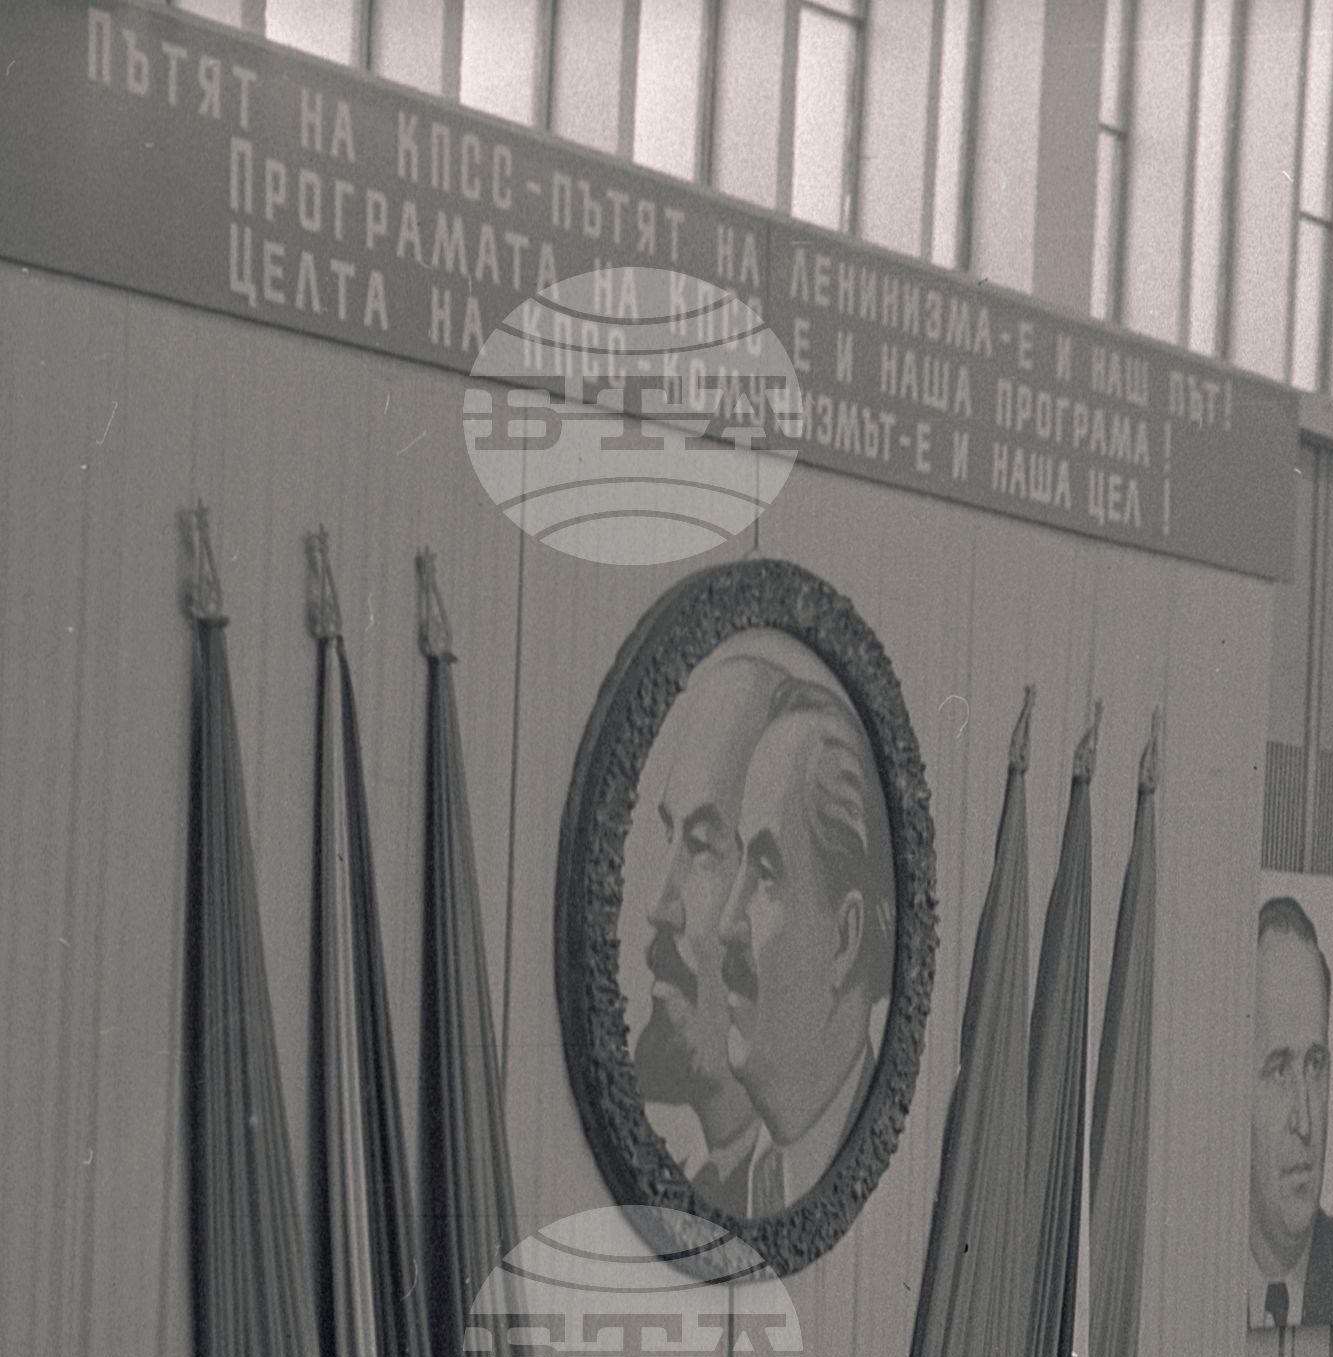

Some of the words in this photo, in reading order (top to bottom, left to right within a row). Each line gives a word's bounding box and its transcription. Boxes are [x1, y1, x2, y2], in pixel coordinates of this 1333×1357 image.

[88, 7, 257, 131] ПЪТЯТ
[302, 87, 355, 163] НА
[717, 223, 760, 288] НА
[1056, 334, 1073, 382] И
[1091, 348, 1150, 407] НАШ
[230, 136, 561, 301] ПРОГРАМАТА
[594, 257, 639, 322] НА
[668, 267, 764, 355] КПСС
[793, 317, 811, 374] Е
[836, 331, 853, 383] И
[880, 343, 972, 417] НАША
[230, 222, 389, 331] ЦЕЛТА
[430, 286, 487, 356] НА
[953, 431, 970, 481] И
[992, 441, 1072, 511] НАША
